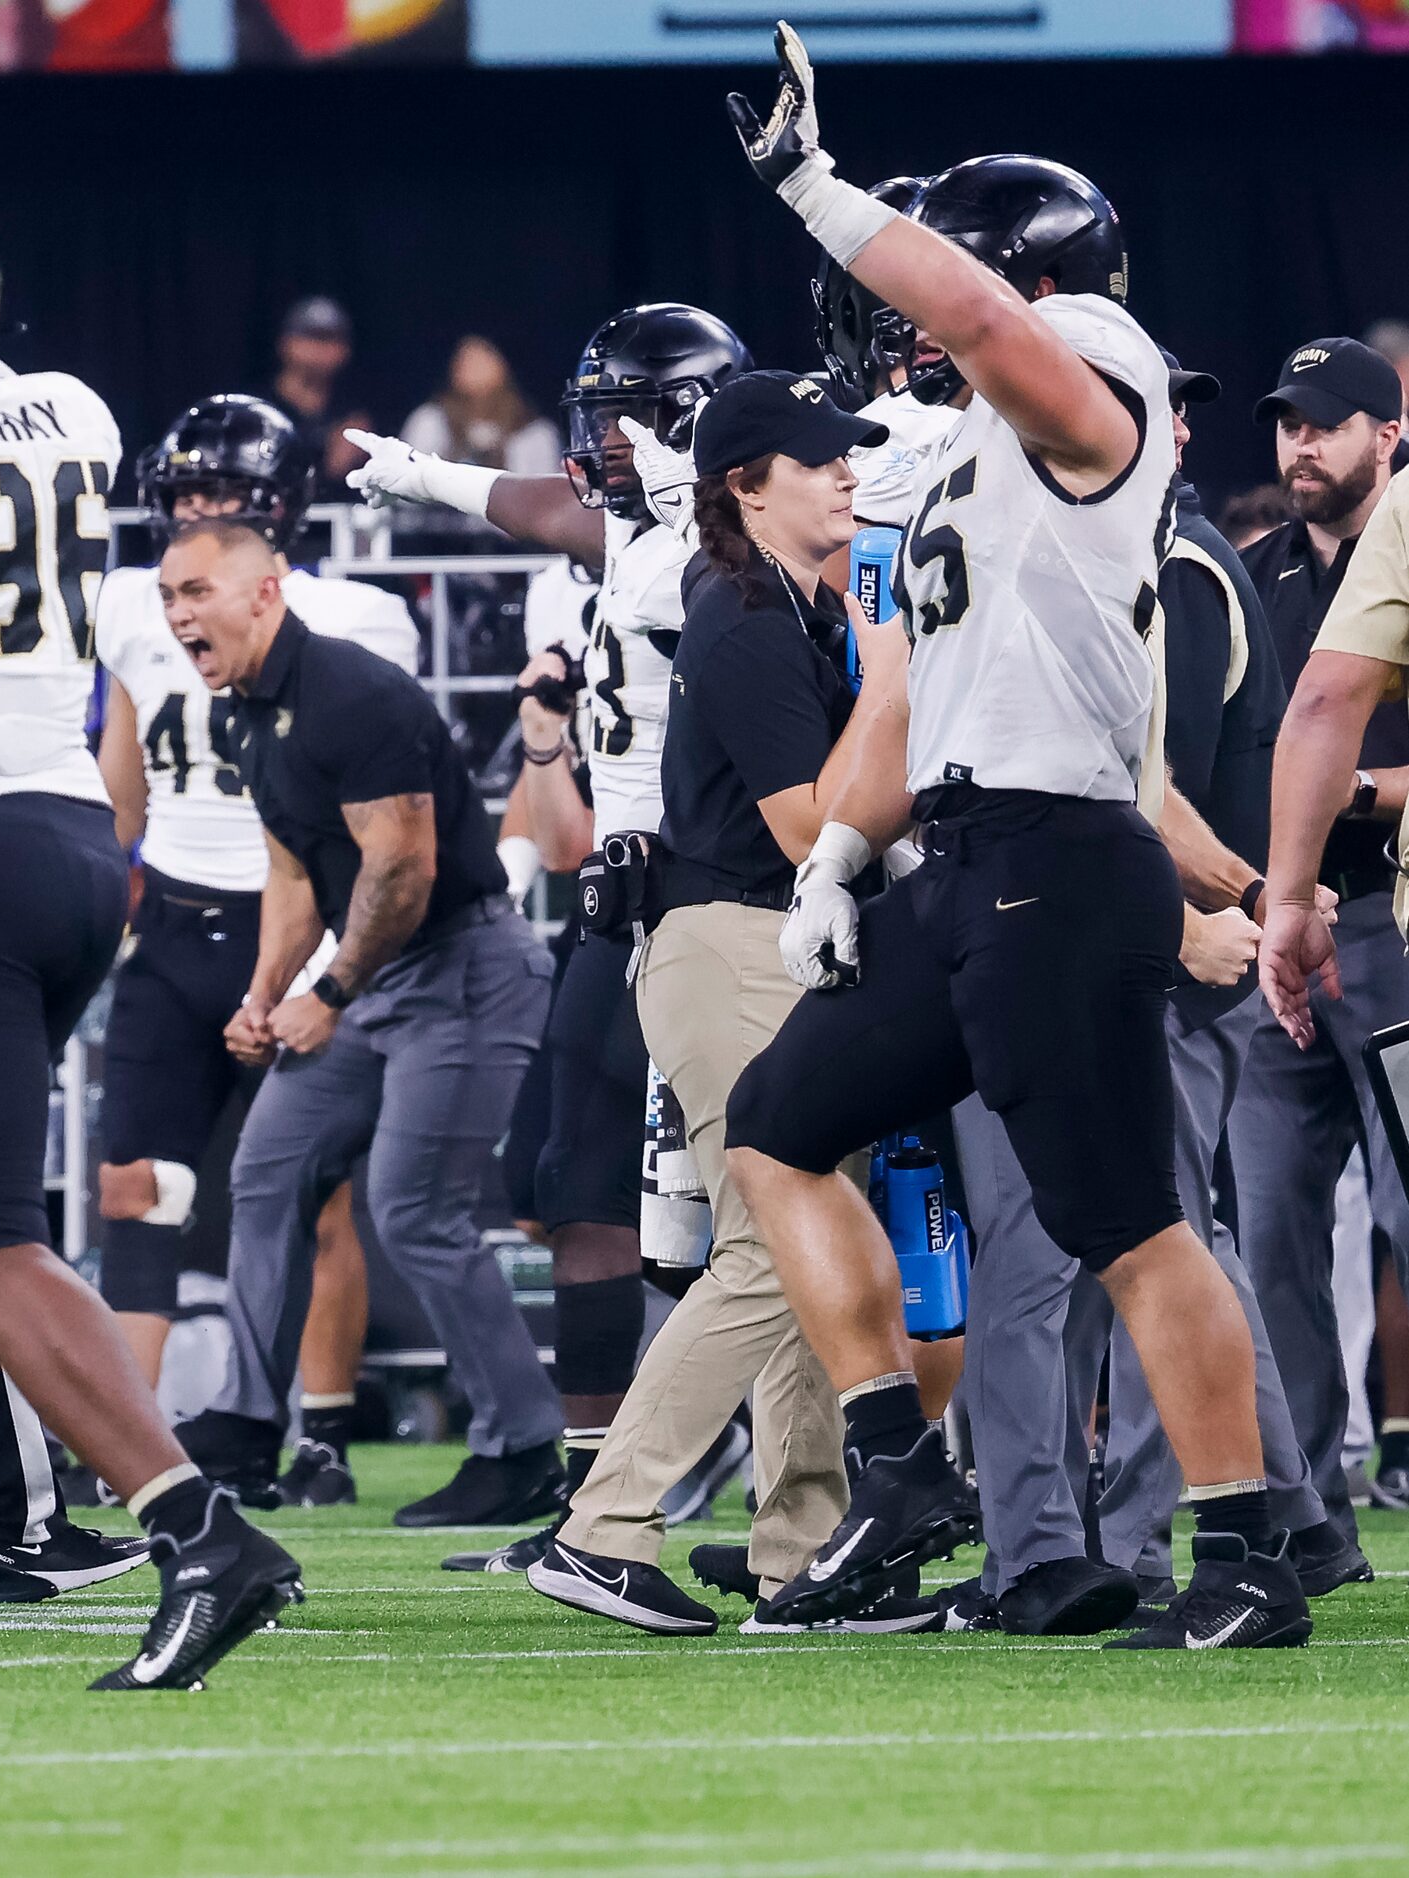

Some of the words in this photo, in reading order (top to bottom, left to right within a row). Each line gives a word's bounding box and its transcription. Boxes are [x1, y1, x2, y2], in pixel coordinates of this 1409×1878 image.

[1290, 348, 1331, 366] ARMY
[949, 766, 965, 780] XL
[928, 1192, 945, 1255] POWE
[1235, 1582, 1268, 1600] ALPHA
